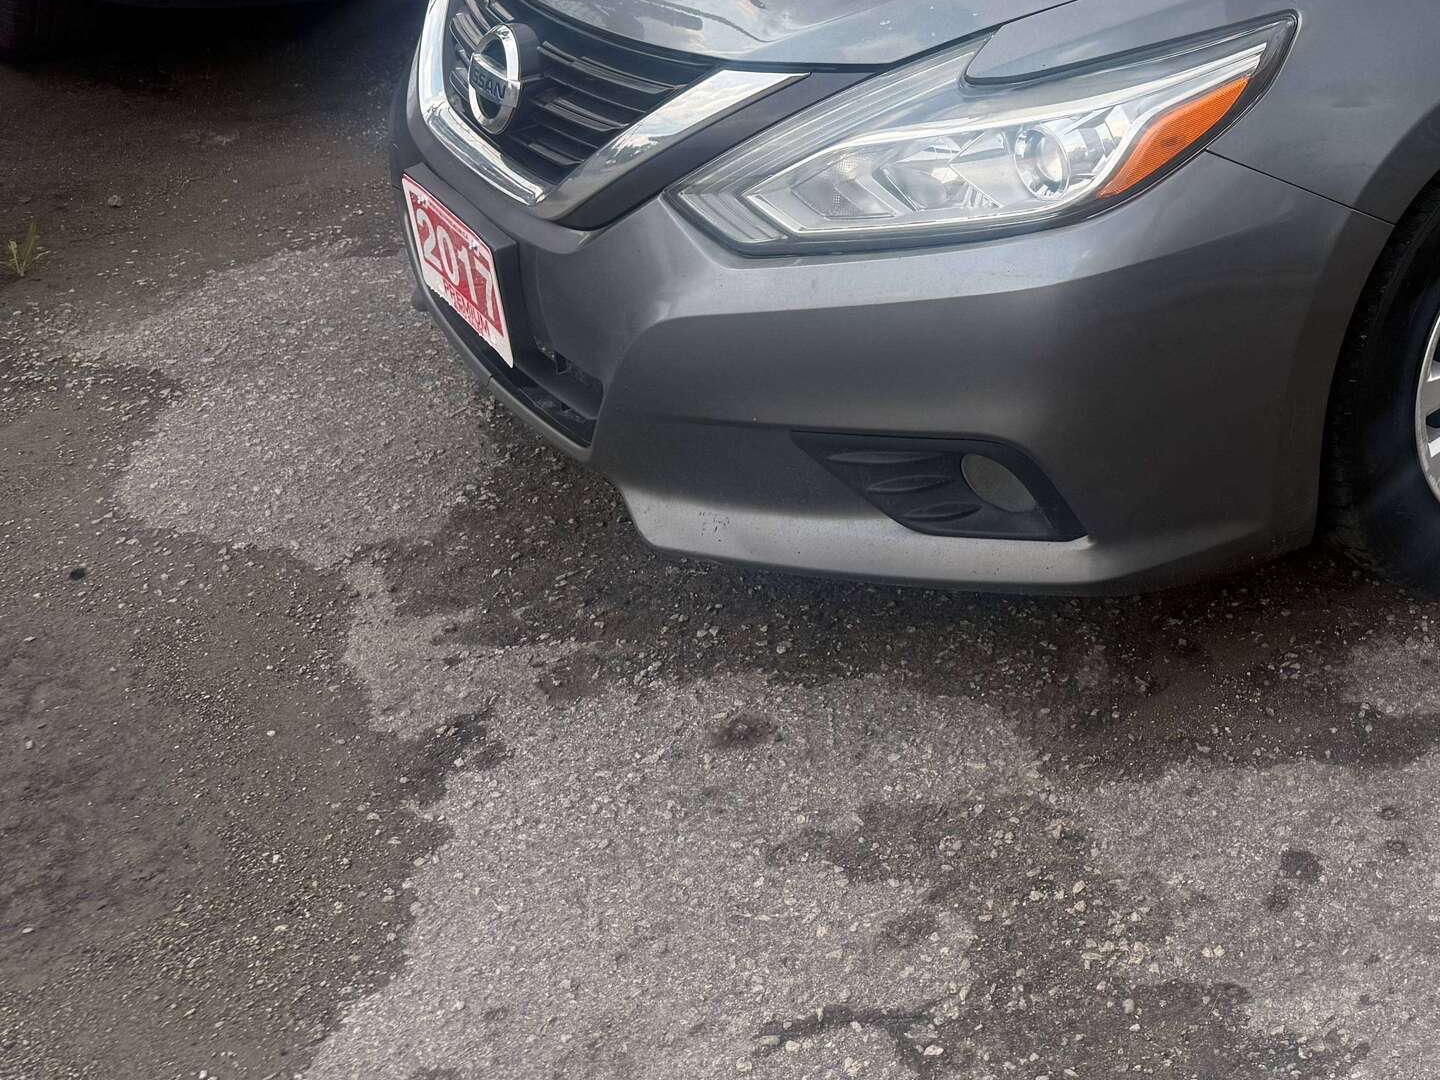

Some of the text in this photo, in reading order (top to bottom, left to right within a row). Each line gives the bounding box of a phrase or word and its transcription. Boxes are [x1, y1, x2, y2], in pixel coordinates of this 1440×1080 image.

[472, 68, 506, 99] SSAN
[416, 208, 494, 322] 2017
[444, 280, 491, 336] PREMIUM
